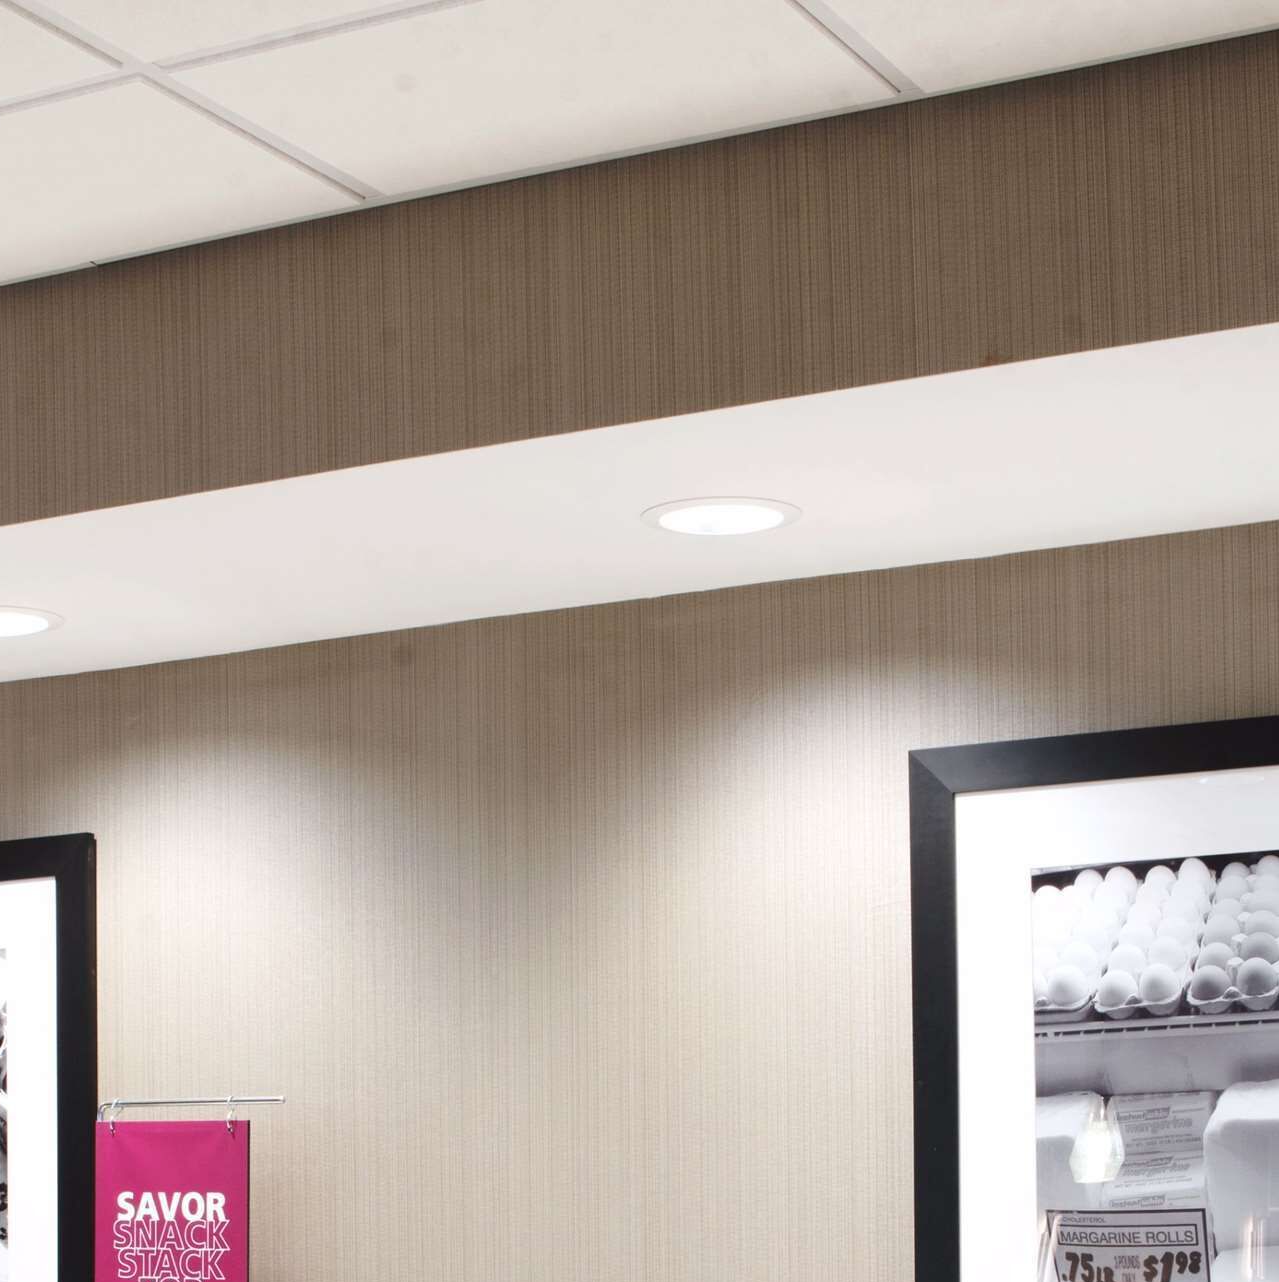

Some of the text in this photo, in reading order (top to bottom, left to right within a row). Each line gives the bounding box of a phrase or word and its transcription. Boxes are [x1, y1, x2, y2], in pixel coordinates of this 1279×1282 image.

[116, 1191, 226, 1222] SAVOR
[112, 1218, 230, 1251] SNACK
[1060, 1230, 1194, 1244] MARGARINE ROLLS
[117, 1247, 226, 1281] STACK
